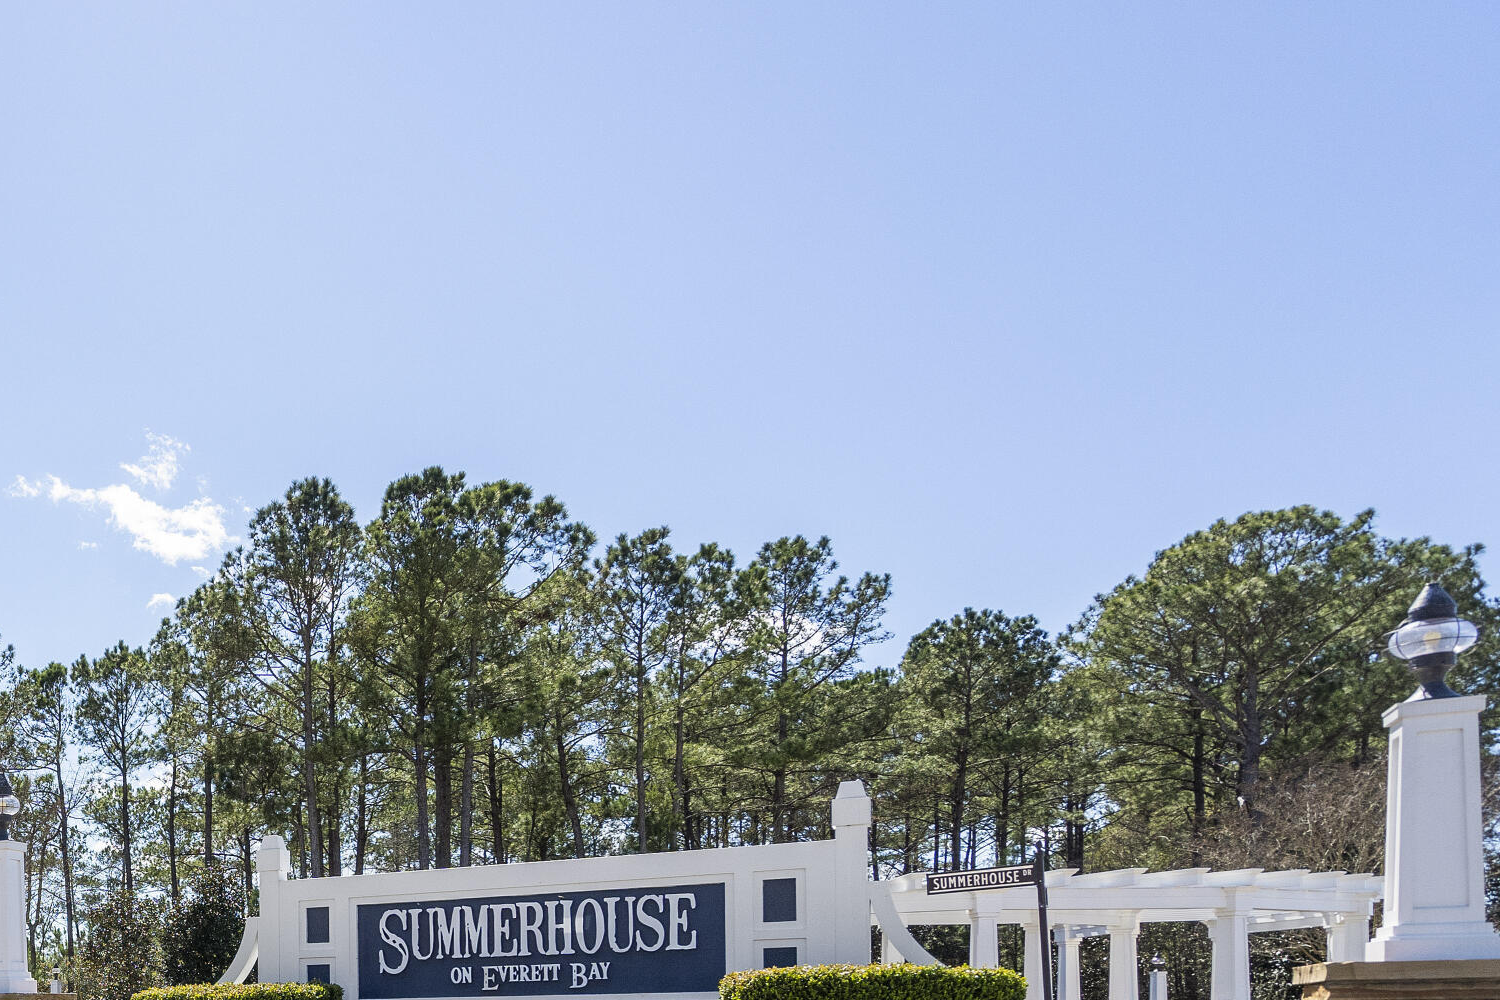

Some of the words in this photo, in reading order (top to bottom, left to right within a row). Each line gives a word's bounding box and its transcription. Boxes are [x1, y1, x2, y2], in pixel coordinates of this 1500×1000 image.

[933, 870, 1020, 890] SUMMERHOUSE
[1022, 868, 1032, 877] DR
[378, 892, 697, 975] SUMMERHOUSE
[450, 967, 472, 984] ON
[481, 963, 560, 991] EVERETT
[570, 961, 610, 989] BAY
